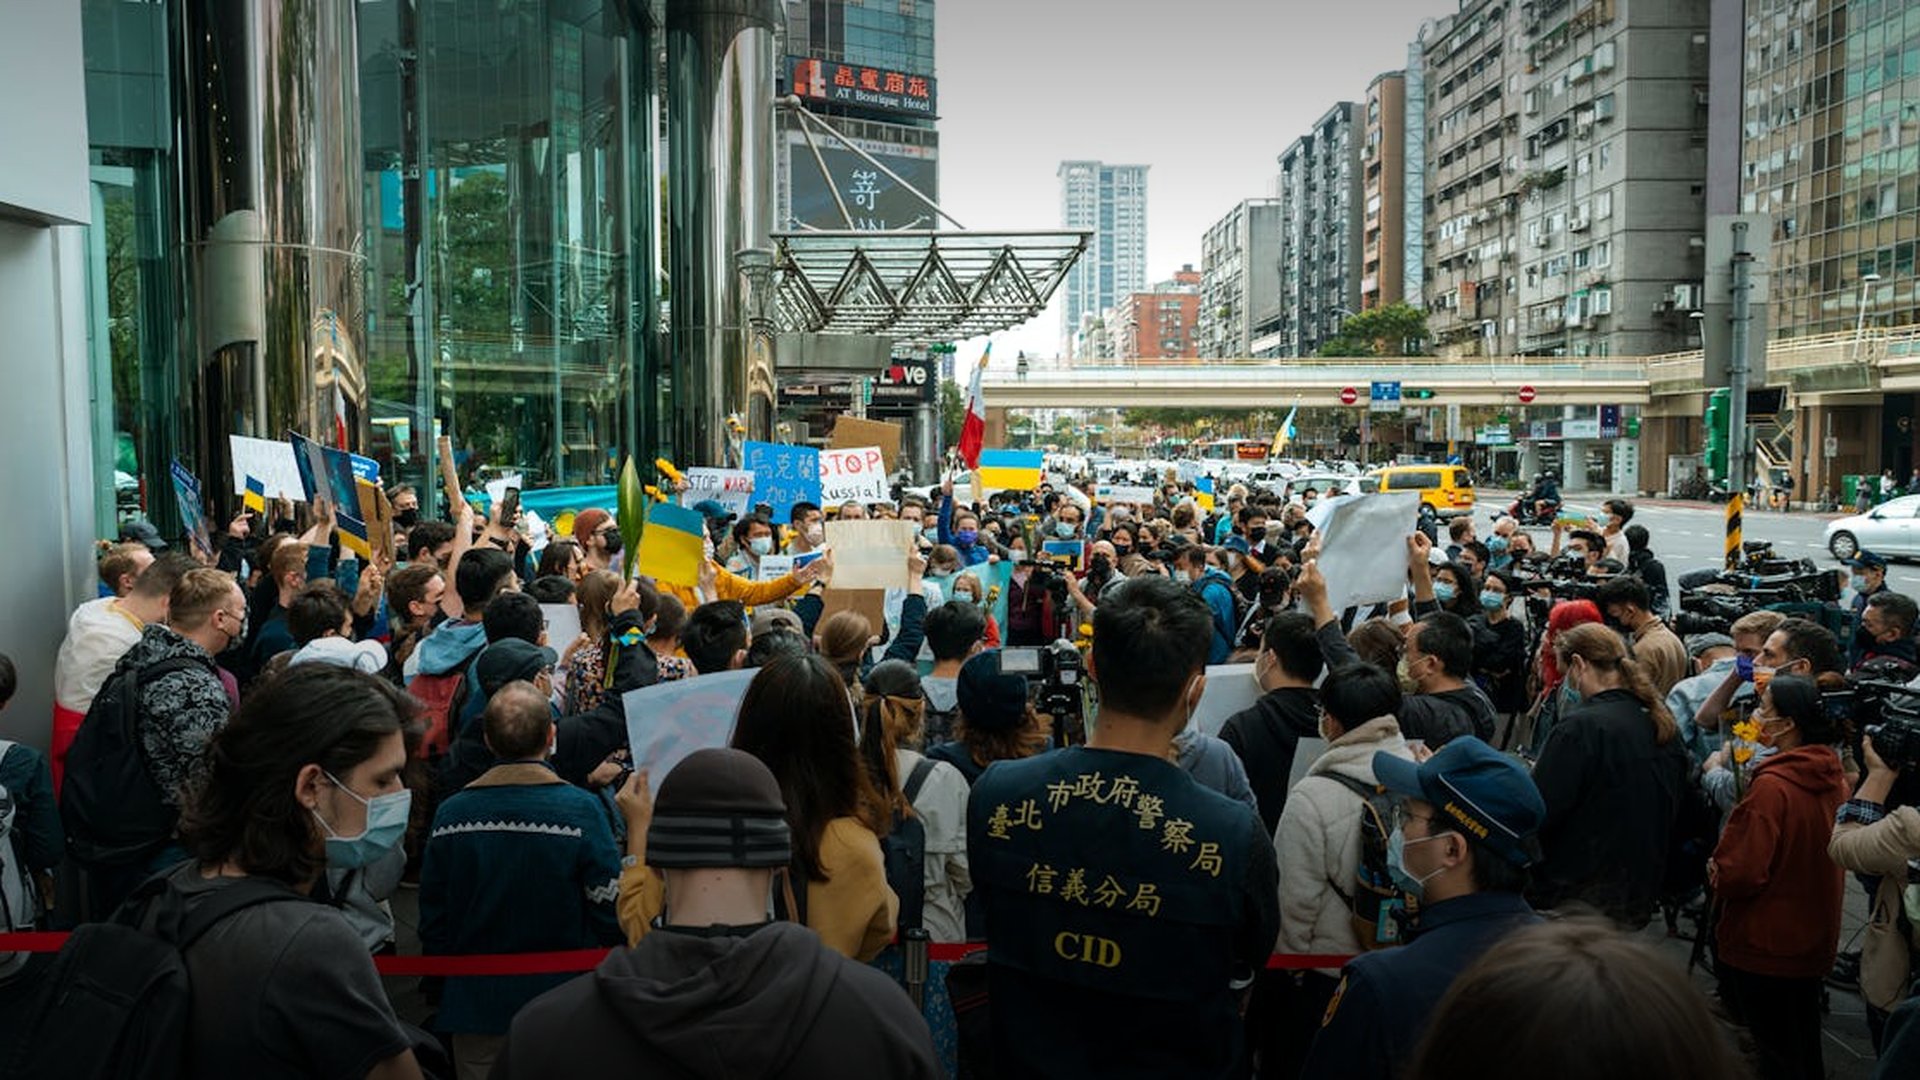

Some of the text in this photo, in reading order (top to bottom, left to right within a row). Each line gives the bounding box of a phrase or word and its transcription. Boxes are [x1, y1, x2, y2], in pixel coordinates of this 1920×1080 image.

[836, 88, 930, 111] AT Boutique Hotel
[688, 475, 717, 491] STOP
[766, 486, 808, 504] 加油
[988, 772, 1223, 877] 臺北市政府警察局
[1026, 862, 1162, 917] 信義分局
[1054, 931, 1122, 968] CID
